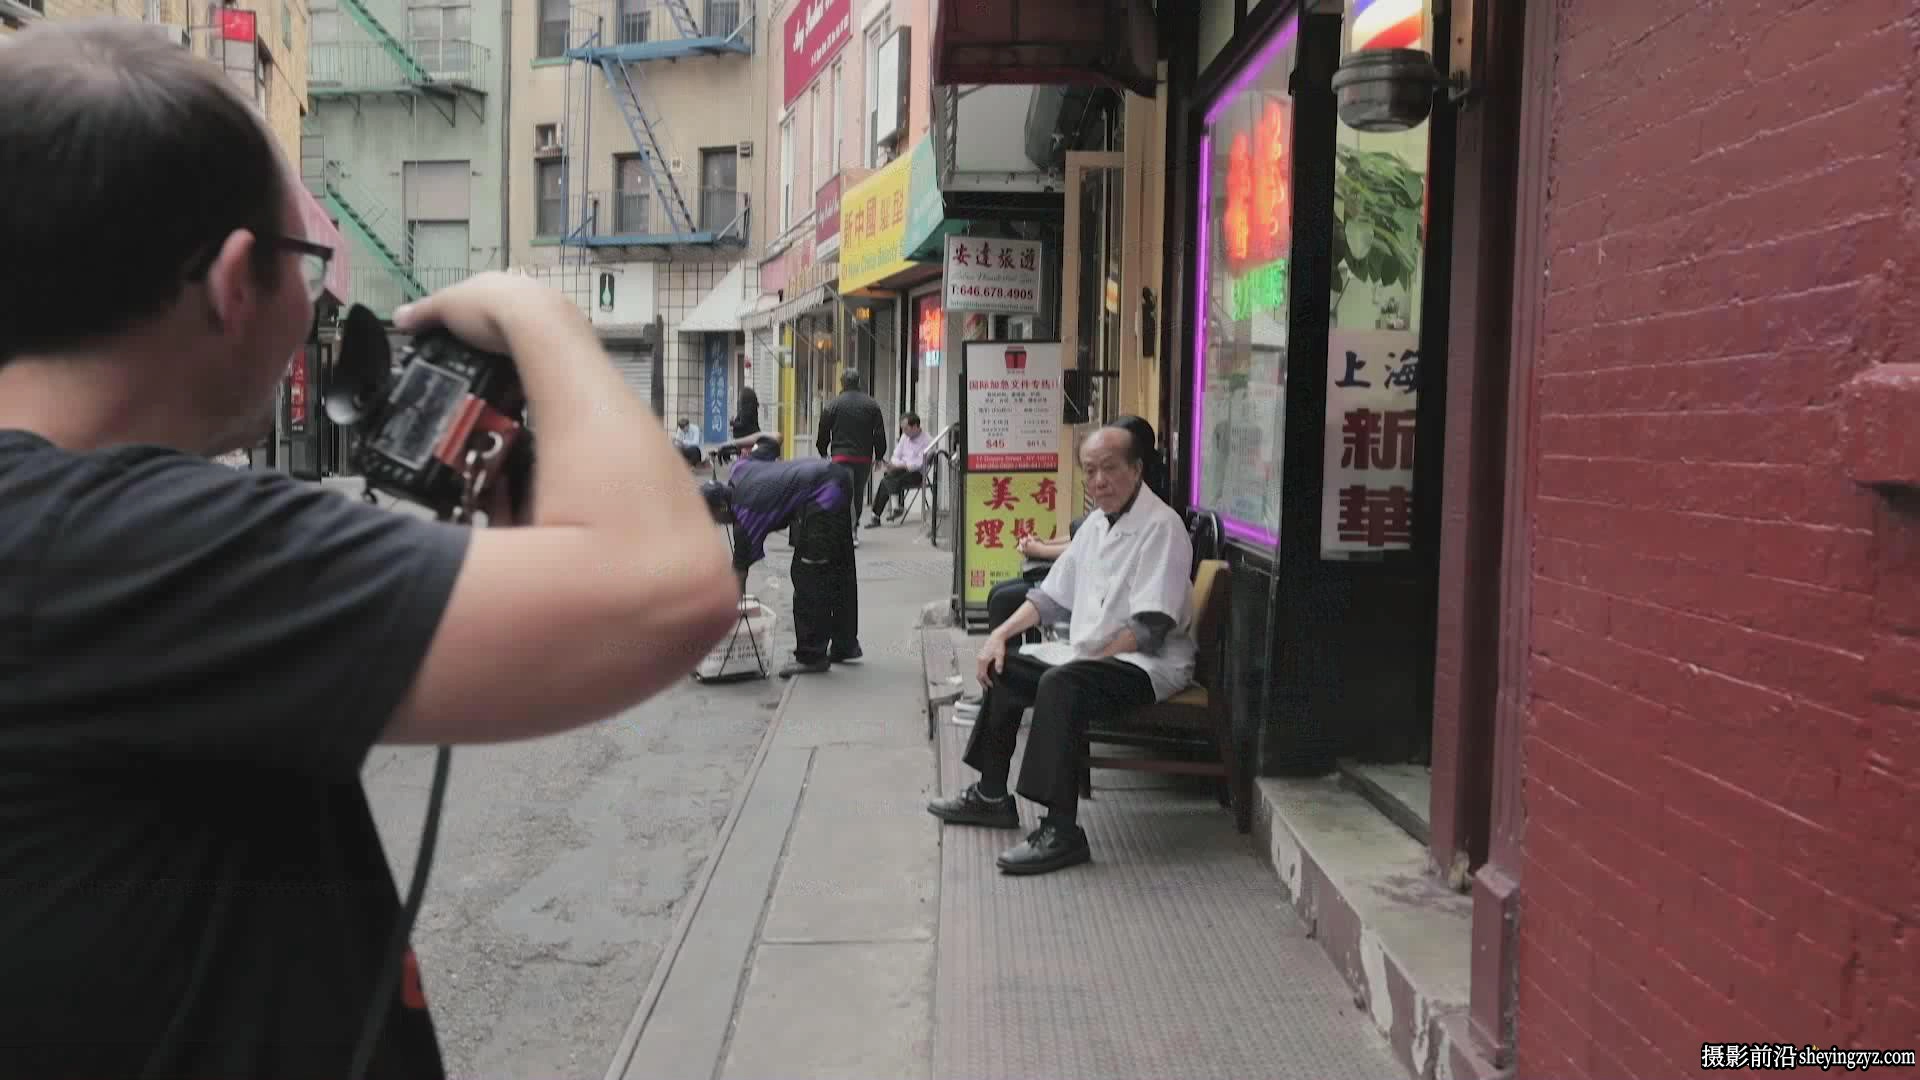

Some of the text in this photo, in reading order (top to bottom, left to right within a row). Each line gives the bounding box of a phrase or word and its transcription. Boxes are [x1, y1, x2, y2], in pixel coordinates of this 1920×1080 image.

[953, 241, 1036, 271] 安達旅遊
[1335, 350, 1418, 393] 上海
[985, 439, 1005, 448] $45
[975, 518, 1057, 549] 理髮
